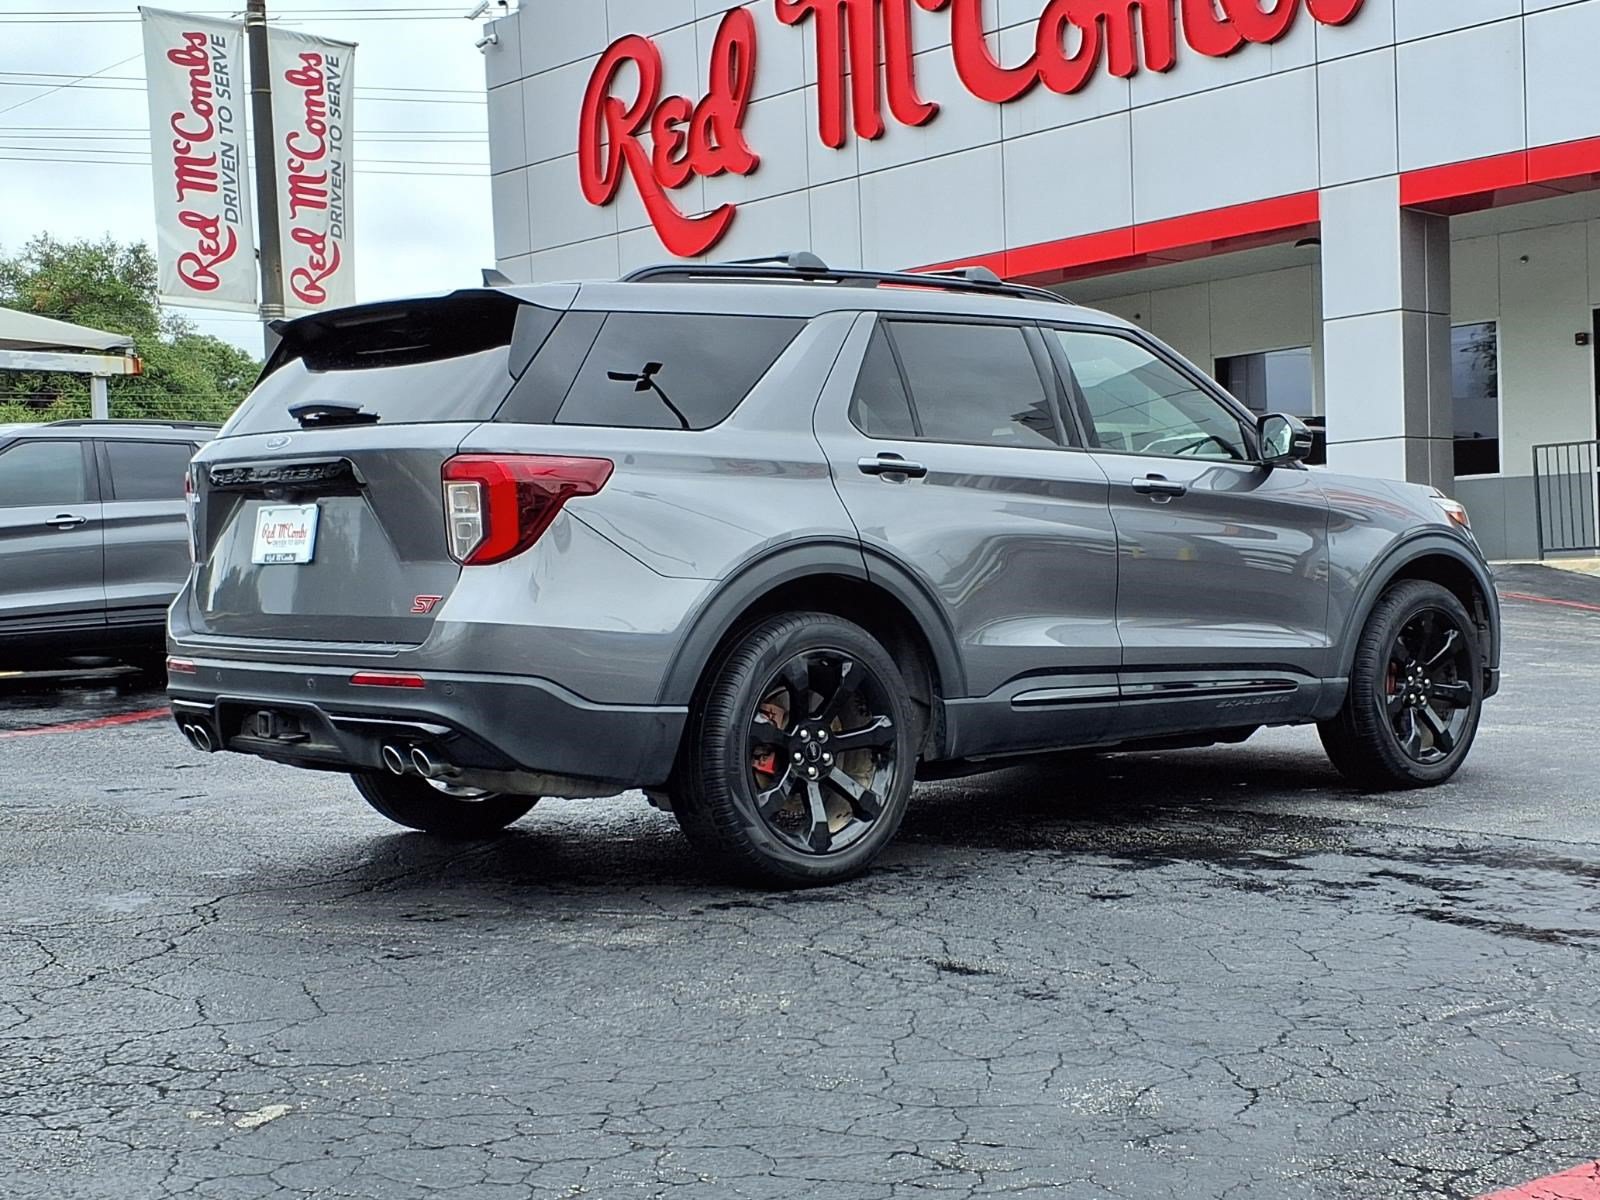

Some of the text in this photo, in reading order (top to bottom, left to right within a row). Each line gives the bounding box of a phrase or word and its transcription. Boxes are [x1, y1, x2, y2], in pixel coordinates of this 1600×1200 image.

[167, 31, 237, 292] Red McCombs
[211, 34, 238, 225] DRIVEN TO SERVE
[285, 52, 341, 305] Red McCombs
[325, 55, 343, 239] DRIVEN TO SERVE
[578, 7, 758, 257] Red
[411, 595, 442, 614] ST
